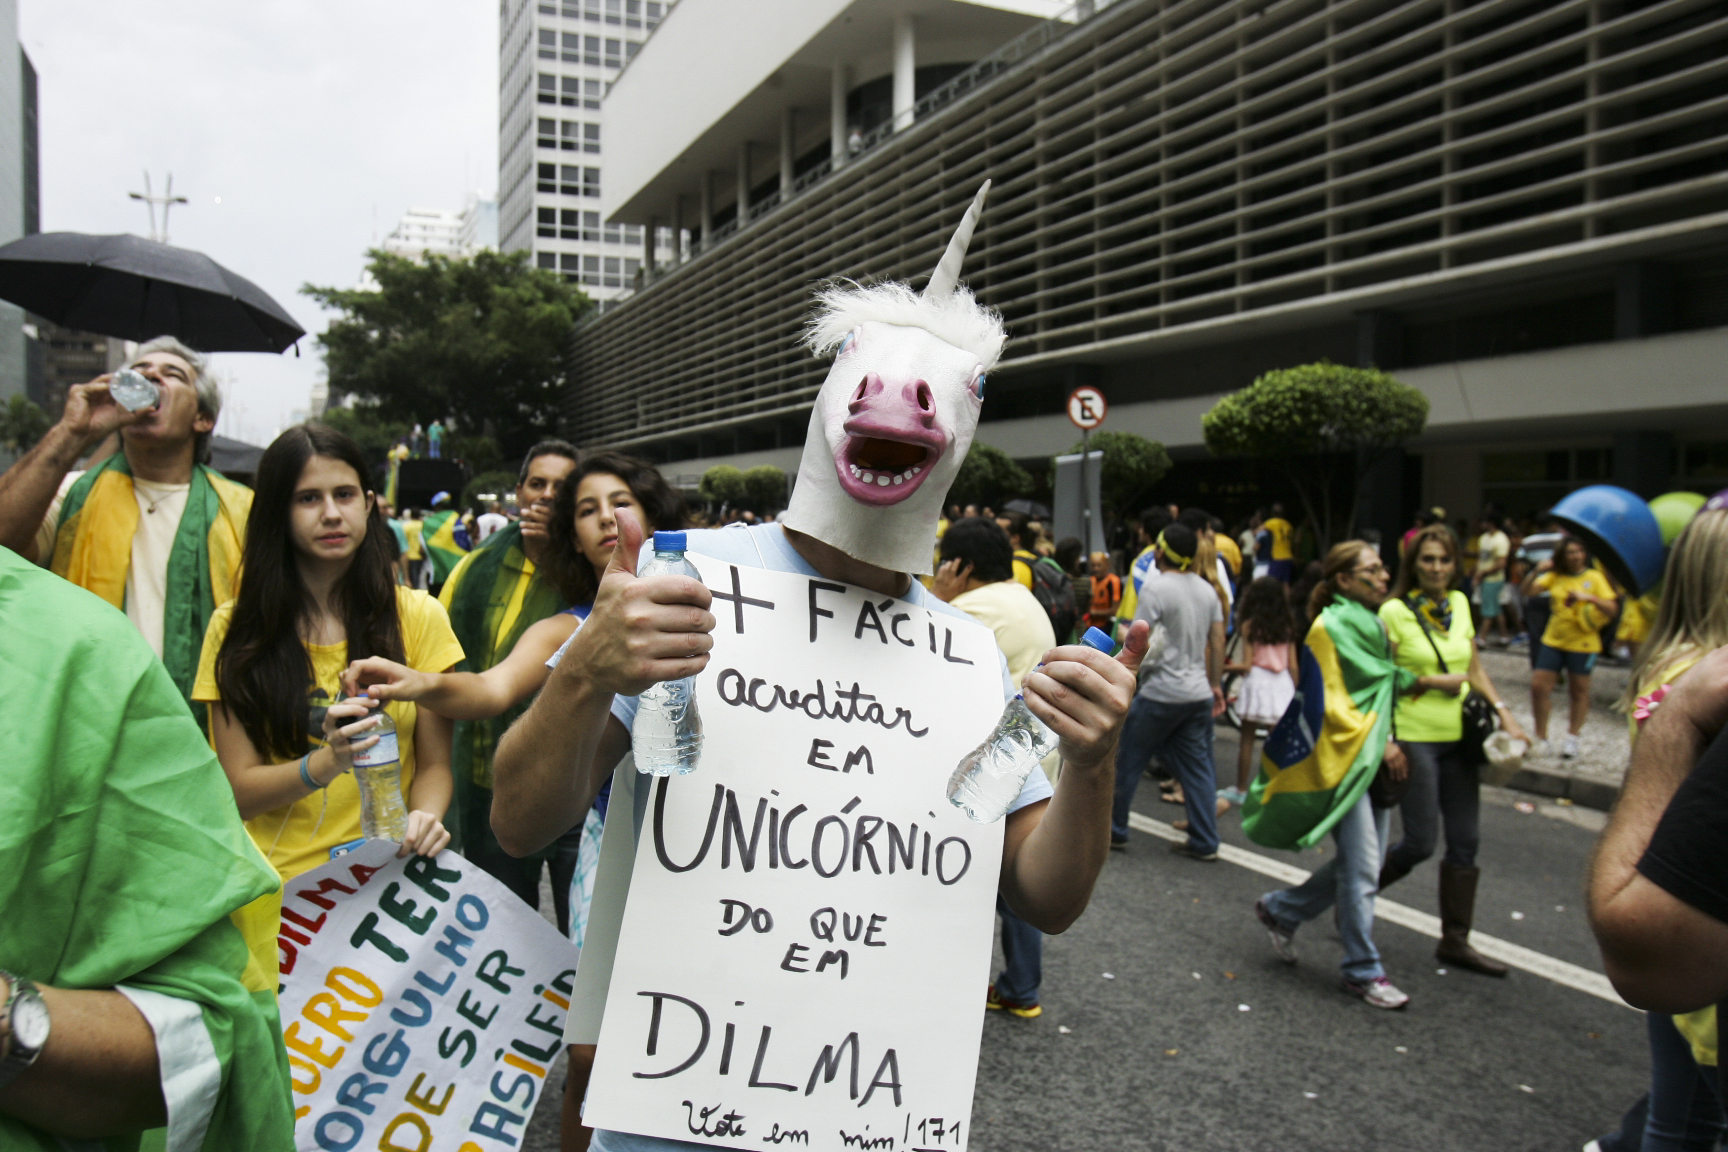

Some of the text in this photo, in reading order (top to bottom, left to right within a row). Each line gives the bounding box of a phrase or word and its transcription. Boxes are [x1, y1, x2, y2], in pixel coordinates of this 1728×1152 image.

[716, 667, 929, 738] acreditar
[807, 738, 874, 775] EM
[718, 899, 887, 947] DO QUE
[283, 854, 463, 1121] UERO TER
[780, 943, 849, 980] EM
[313, 893, 490, 1152] ORGULHO
[378, 949, 526, 1152] DE SER
[682, 1100, 747, 1138] Vote
[763, 1123, 809, 1147] em
[917, 1117, 961, 1146] 171
